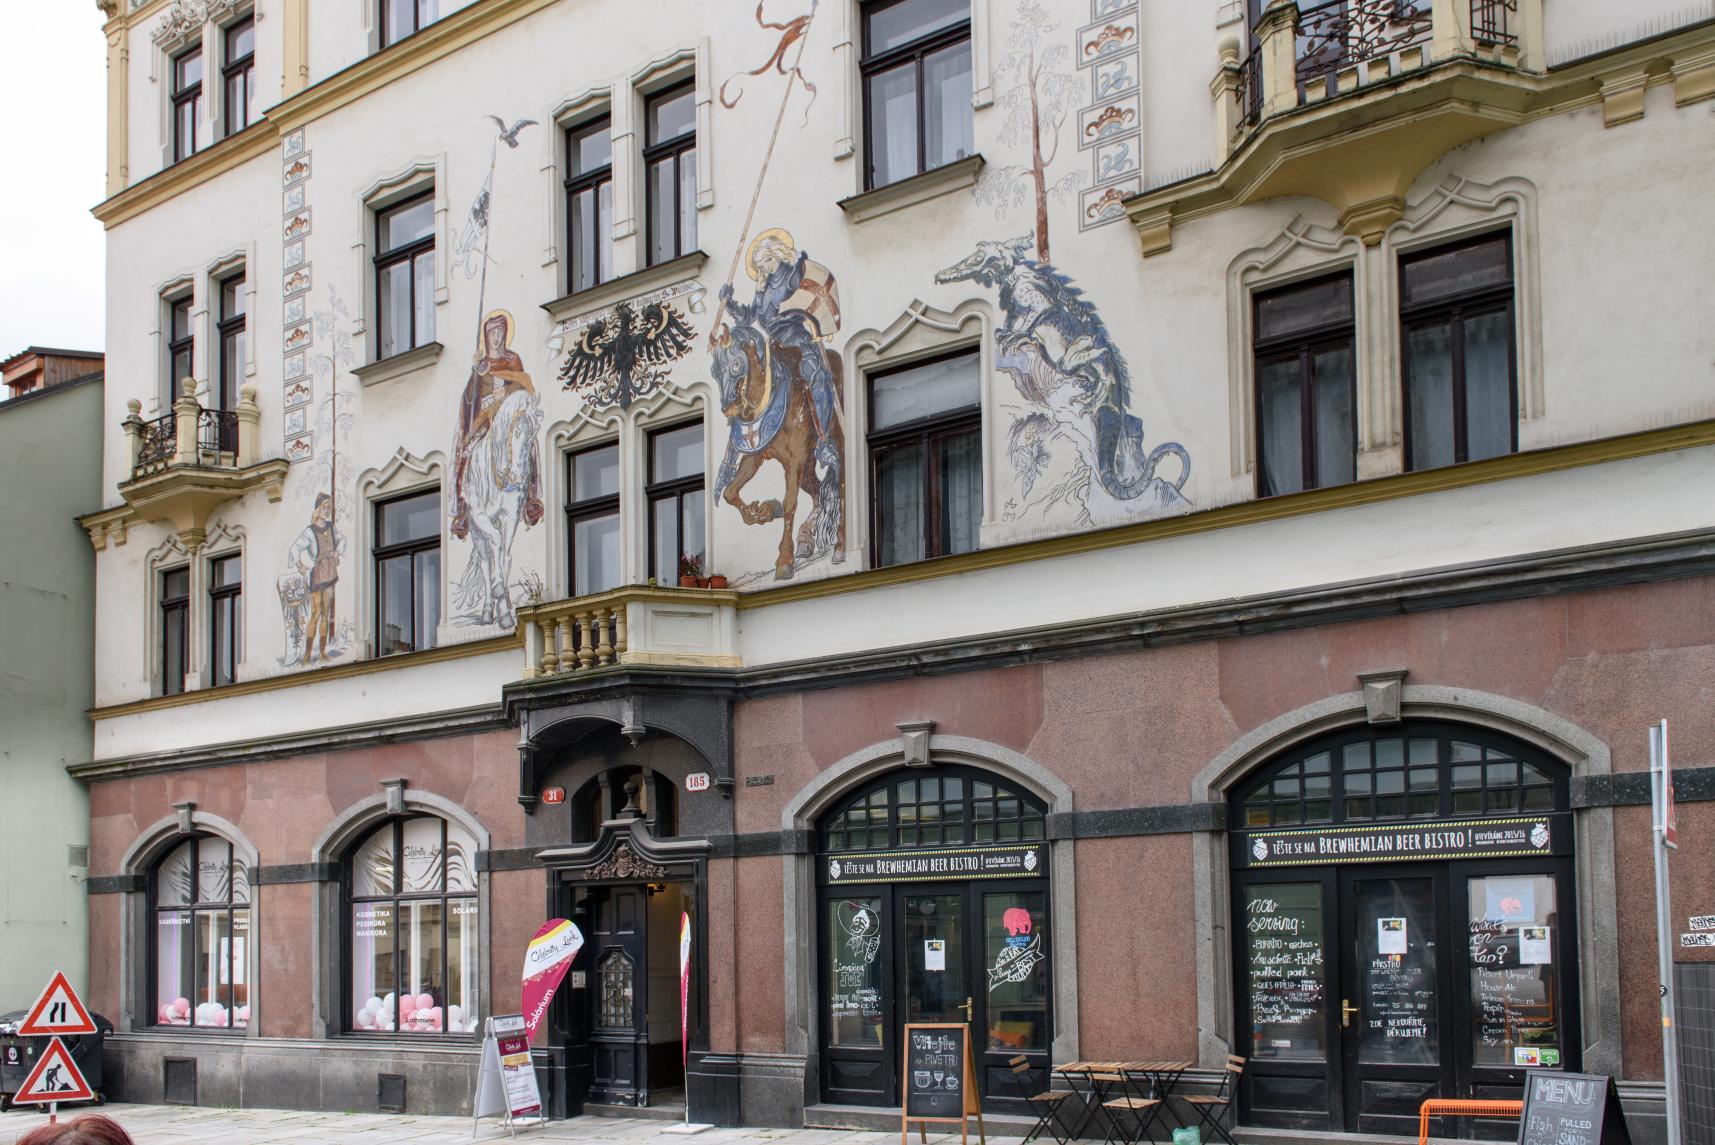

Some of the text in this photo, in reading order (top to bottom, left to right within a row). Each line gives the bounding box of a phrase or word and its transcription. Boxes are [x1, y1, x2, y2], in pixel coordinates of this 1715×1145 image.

[688, 776, 705, 787] 185
[548, 792, 557, 800] 31
[1294, 843, 1302, 854] SE
[1304, 842, 1316, 853] NA
[1320, 835, 1392, 854] BREWHEMIAN
[1396, 834, 1420, 850] BEER
[1424, 832, 1464, 848] BISTRO
[858, 864, 864, 874] SE
[866, 864, 874, 873] NA
[876, 858, 928, 874] BREWHEMIAN
[930, 858, 948, 872] BEER
[950, 858, 978, 870] BISTRO
[530, 930, 579, 962] Celebrity Look
[1254, 966, 1308, 980] pulled pork
[526, 988, 554, 1030] Solárium
[1536, 1078, 1594, 1104] MENU
[1530, 1115, 1553, 1132] Fish
[1560, 1118, 1592, 1129] PULLED
